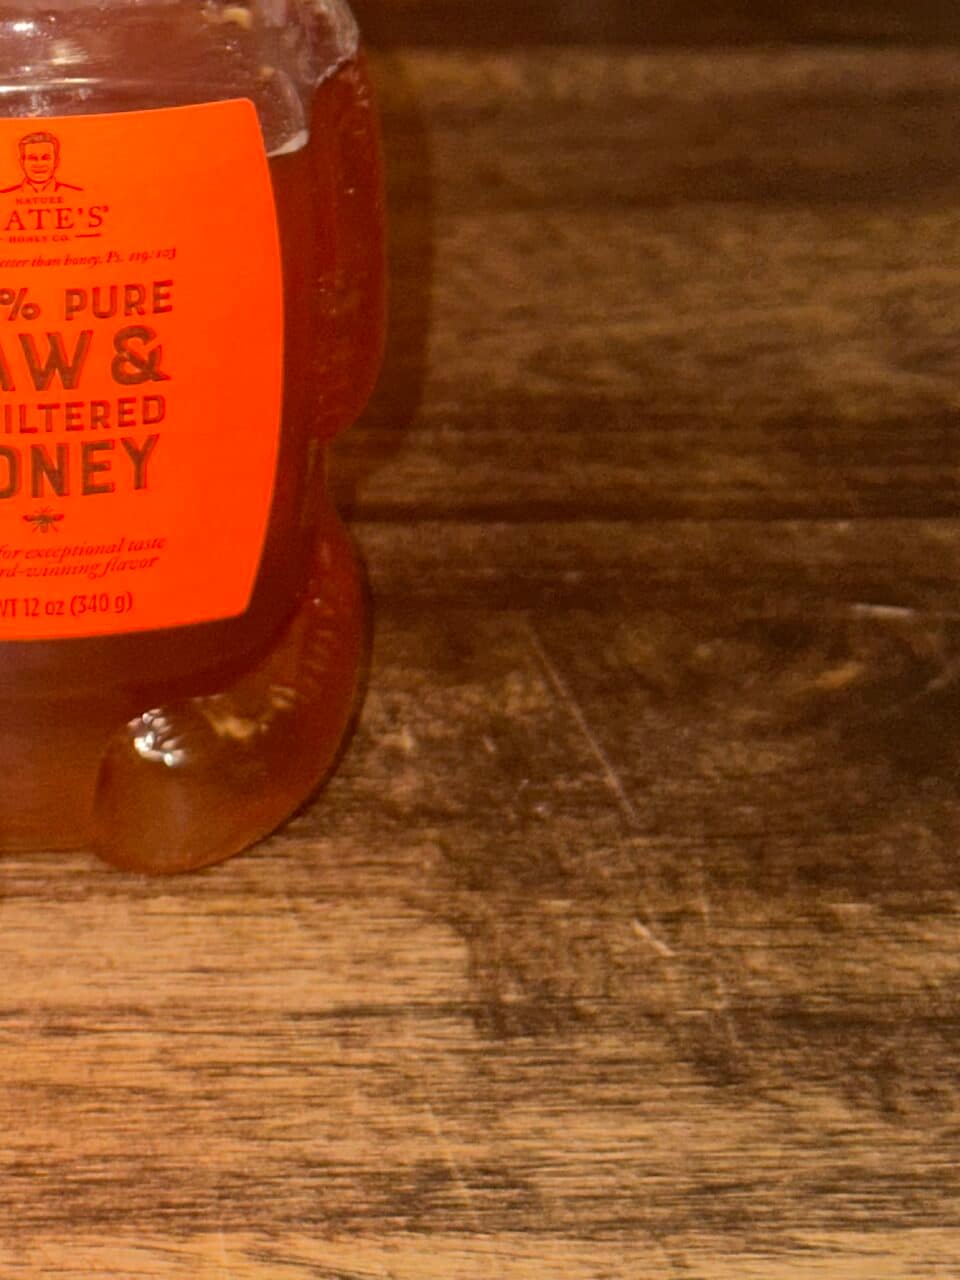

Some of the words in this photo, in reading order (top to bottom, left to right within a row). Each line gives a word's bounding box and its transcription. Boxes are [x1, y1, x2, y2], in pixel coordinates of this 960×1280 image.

[31, 254, 61, 267] than
[64, 280, 174, 321] PURE
[110, 324, 172, 386] &
[24, 536, 126, 564] exceptional
[126, 537, 167, 553] taste
[96, 554, 161, 578] flavor
[23, 597, 40, 618] 12
[44, 598, 66, 617] oz
[70, 591, 110, 617] (340
[114, 590, 135, 616] g)
